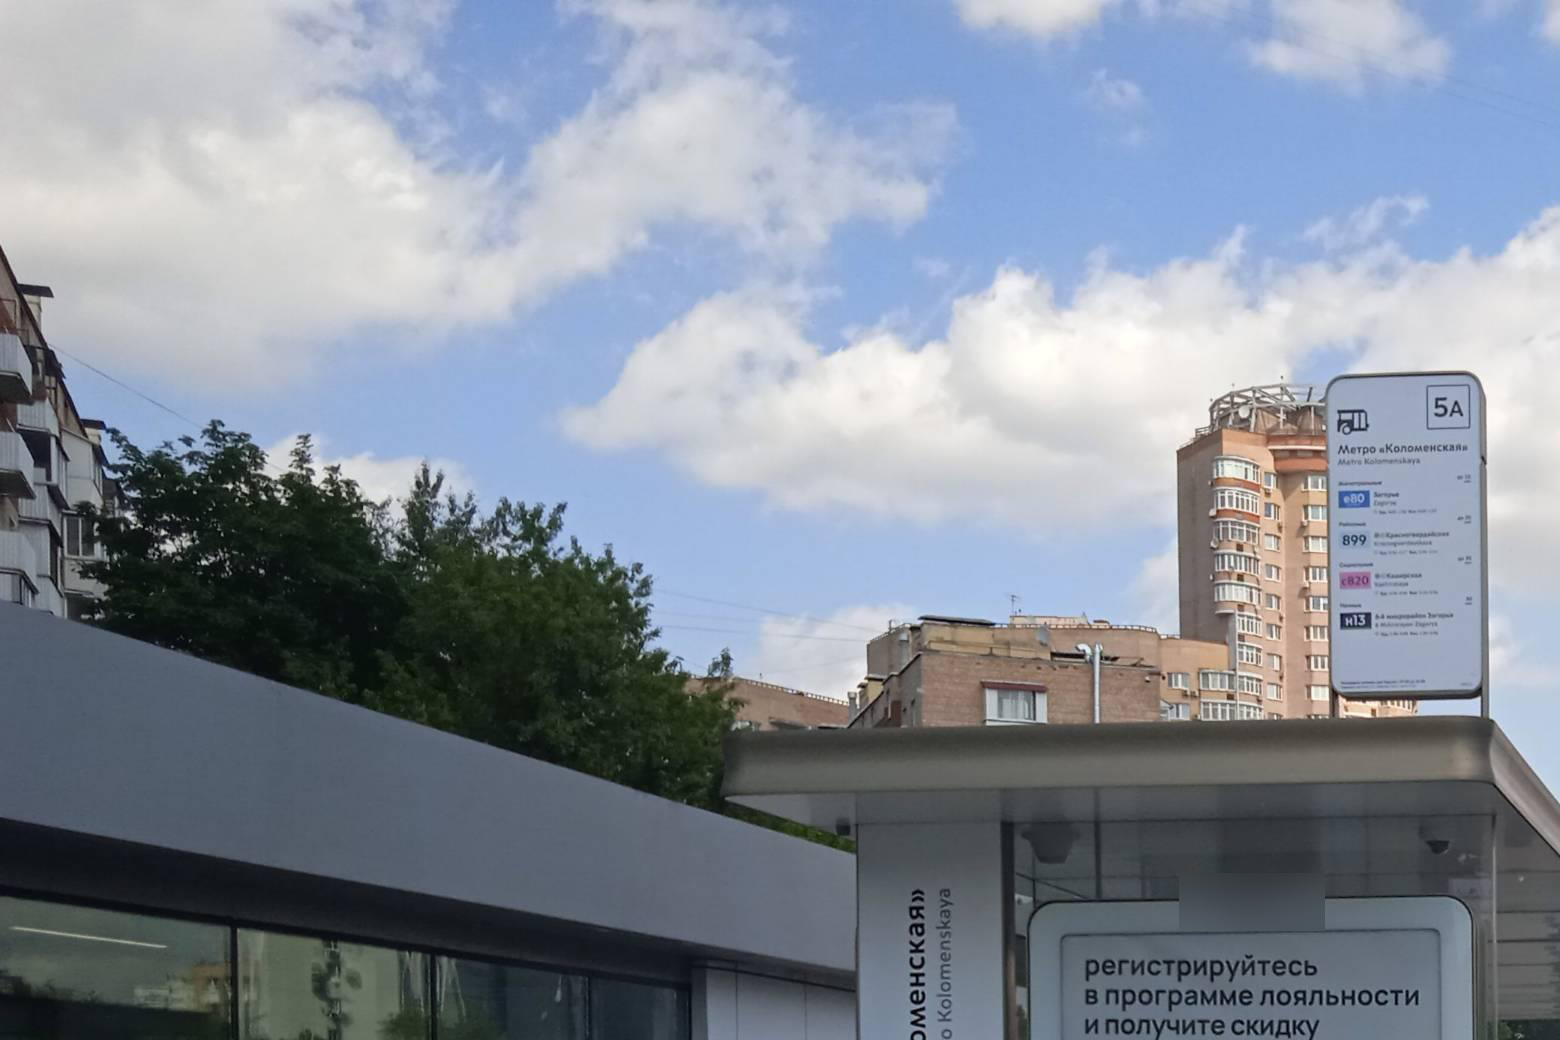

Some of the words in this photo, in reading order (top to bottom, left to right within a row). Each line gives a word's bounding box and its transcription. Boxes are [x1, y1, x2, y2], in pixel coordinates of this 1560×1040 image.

[1434, 397, 1464, 418] 5А
[1338, 445, 1376, 456] Метро
[1379, 443, 1468, 454] «Коломенская»
[1364, 457, 1421, 466] Kolomenskaya
[1342, 534, 1367, 546] 899
[1345, 614, 1366, 627] н13
[936, 888, 955, 1022] Kolomenskaya
[1085, 955, 1318, 982] регистрируйтесь
[1085, 990, 1099, 1005] в
[1105, 987, 1254, 1012] программе
[1259, 986, 1420, 1007] лояльности
[1085, 1019, 1100, 1035] и
[1105, 1016, 1226, 1040] получите
